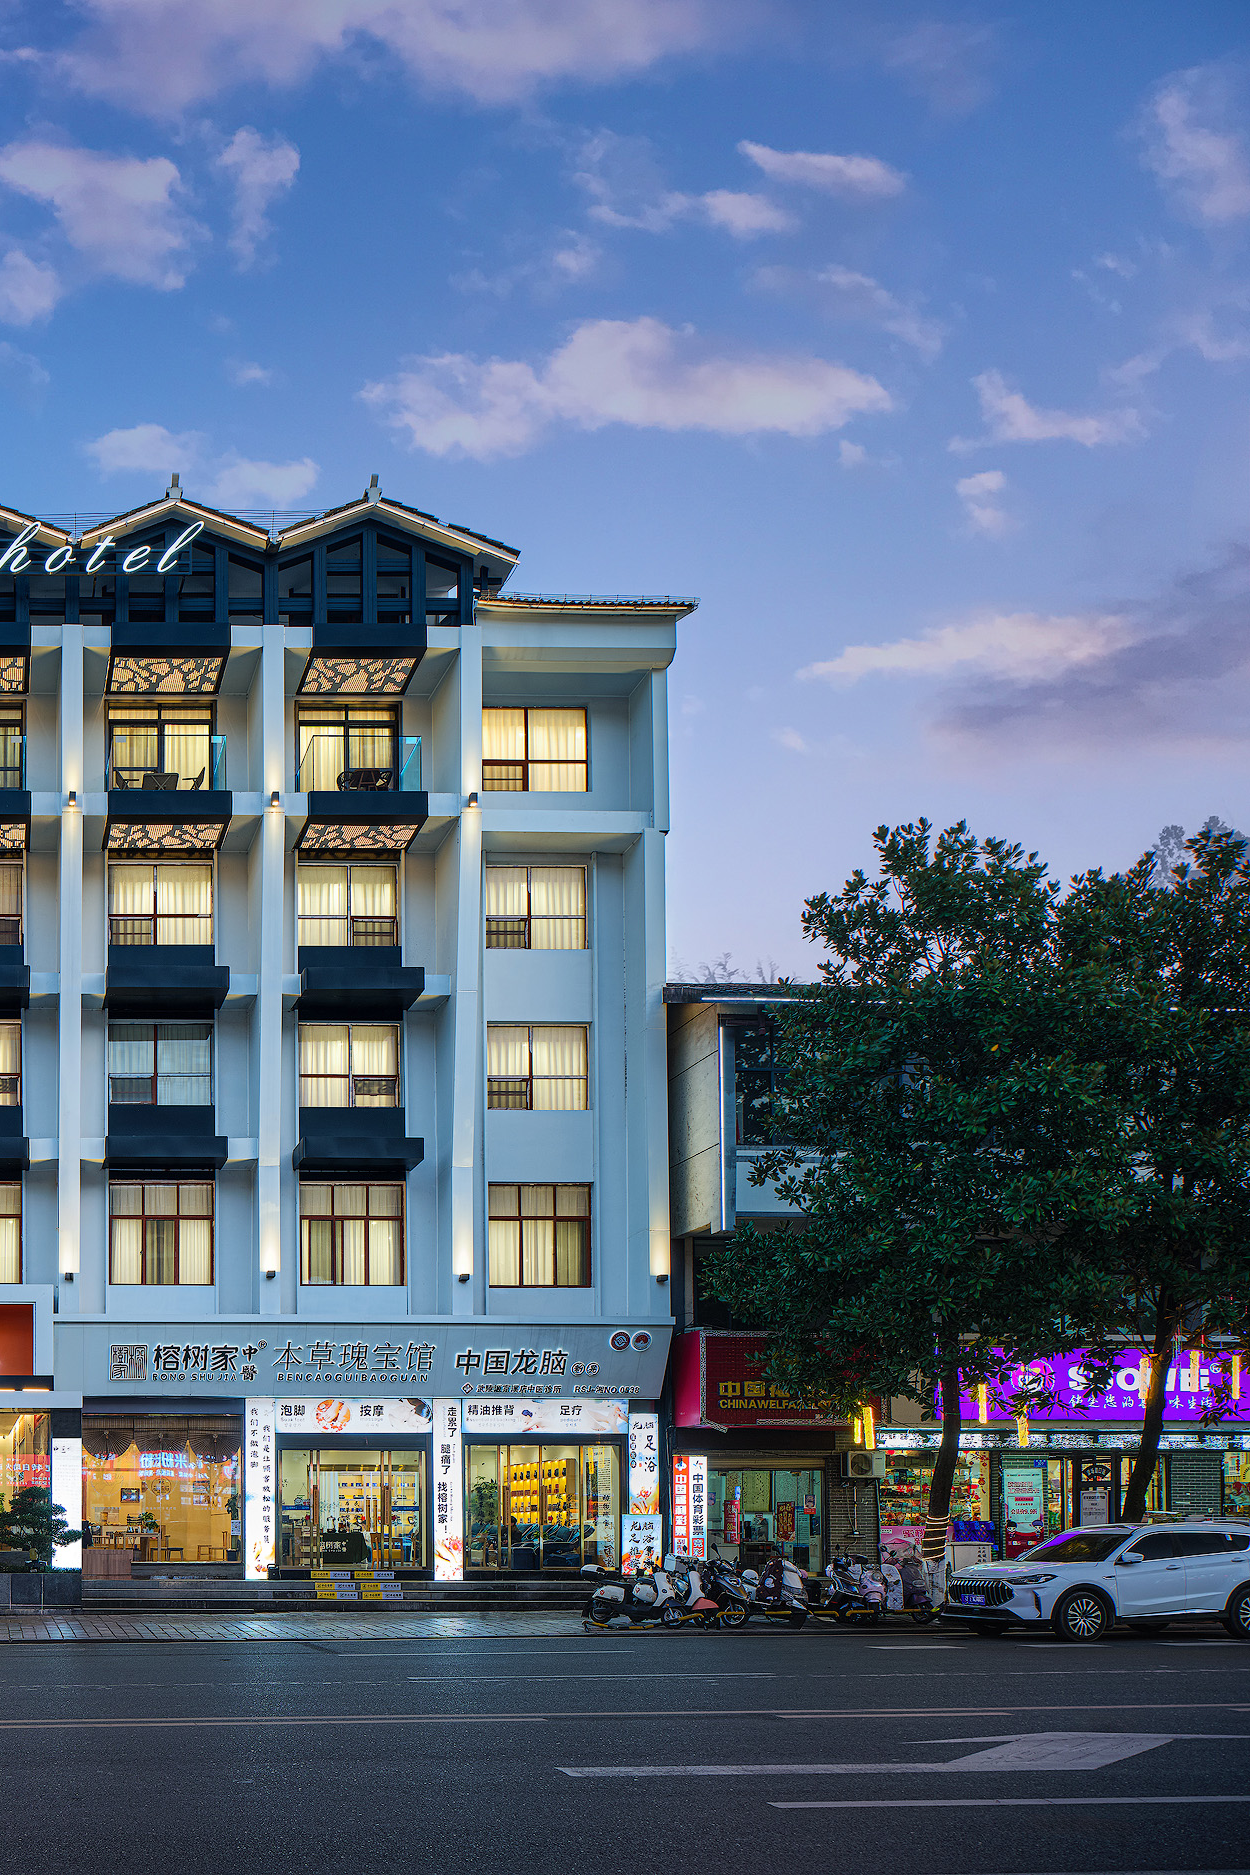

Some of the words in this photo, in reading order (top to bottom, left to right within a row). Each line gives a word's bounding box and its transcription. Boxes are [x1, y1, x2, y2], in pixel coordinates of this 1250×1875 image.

[153, 1344, 239, 1371] 榕树家
[272, 1340, 437, 1372] 本草瑰宝馆
[455, 1348, 569, 1376] 中国龙脑
[152, 1373, 186, 1382] RONG
[191, 1373, 214, 1382] SHU
[217, 1373, 237, 1382] JIA
[277, 1373, 429, 1383] BENCAOGUIBAOGUAN
[280, 1404, 306, 1417] 泡脚
[359, 1404, 384, 1417] 按摩
[467, 1404, 515, 1416] 精油推背
[559, 1404, 583, 1416] 足疗
[447, 1406, 457, 1438] 走累了
[692, 1473, 704, 1536] 中国体育彩票
